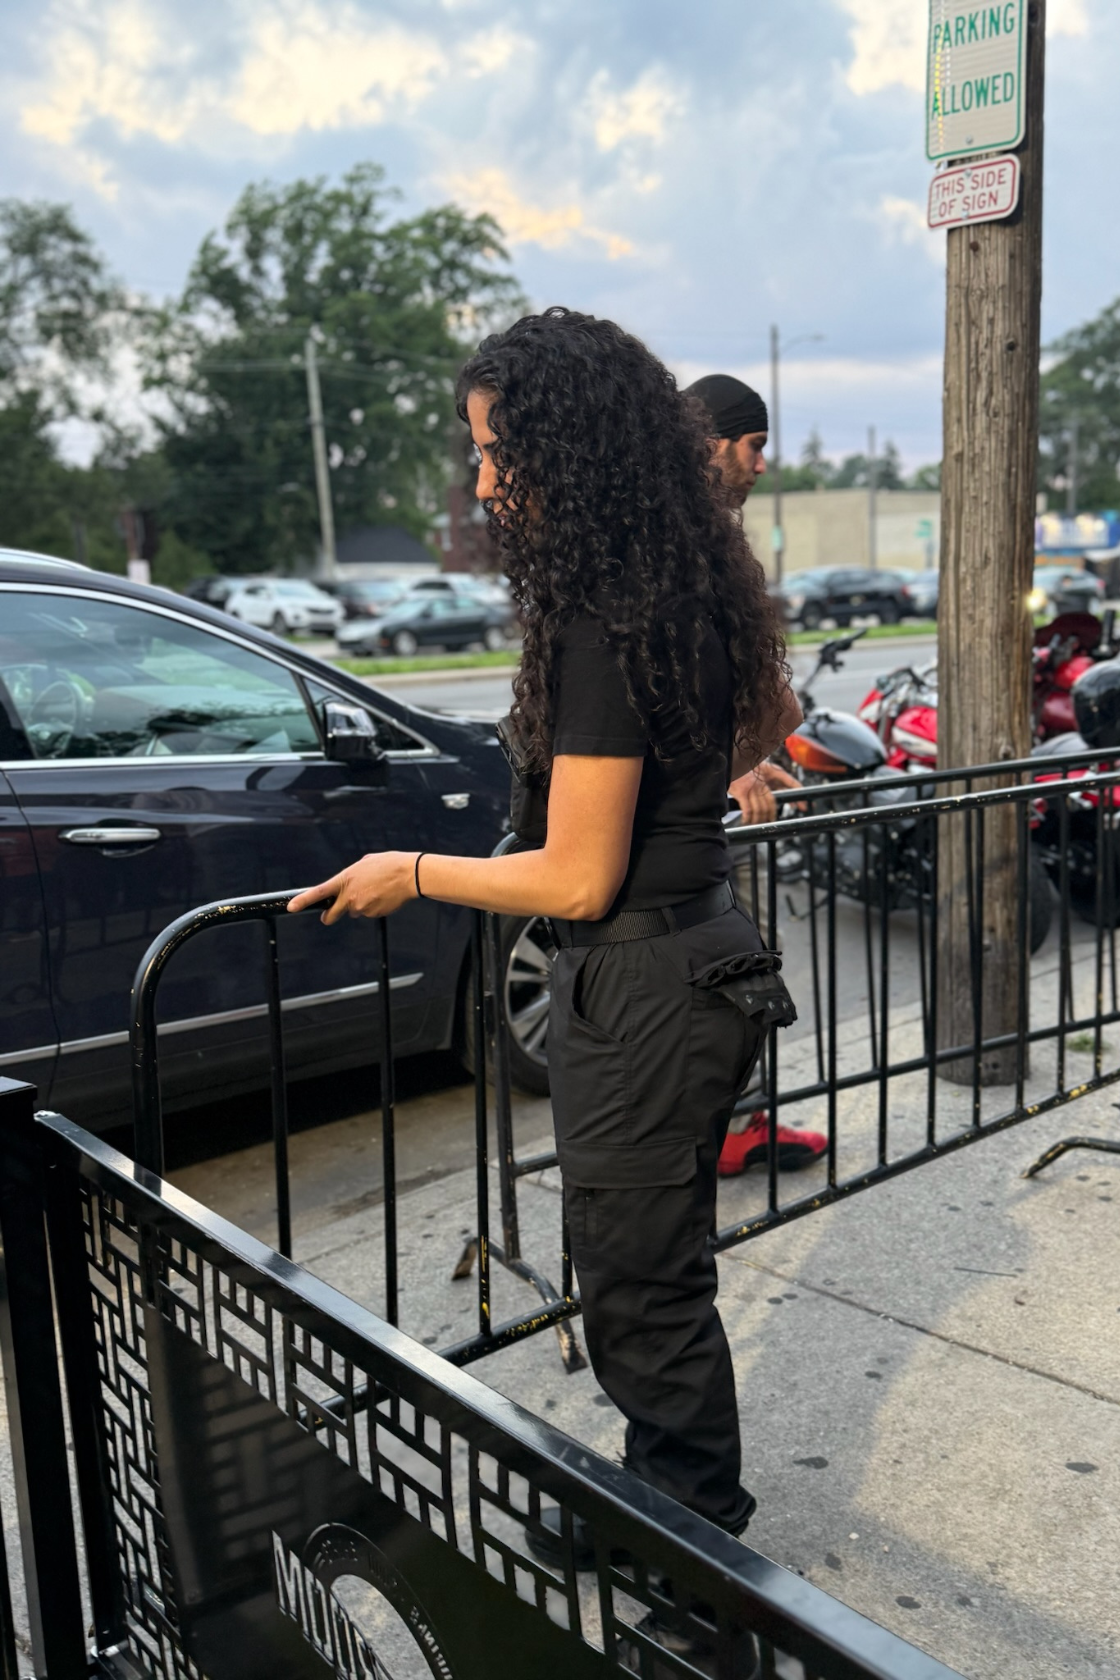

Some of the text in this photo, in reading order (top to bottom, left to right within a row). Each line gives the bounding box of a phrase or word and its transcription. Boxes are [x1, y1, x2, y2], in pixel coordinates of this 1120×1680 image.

[933, 2, 1015, 54] PARKING
[931, 72, 1015, 120] ALLOWED
[935, 168, 1007, 200] THIS SIDE
[938, 190, 998, 218] OF SIGN
